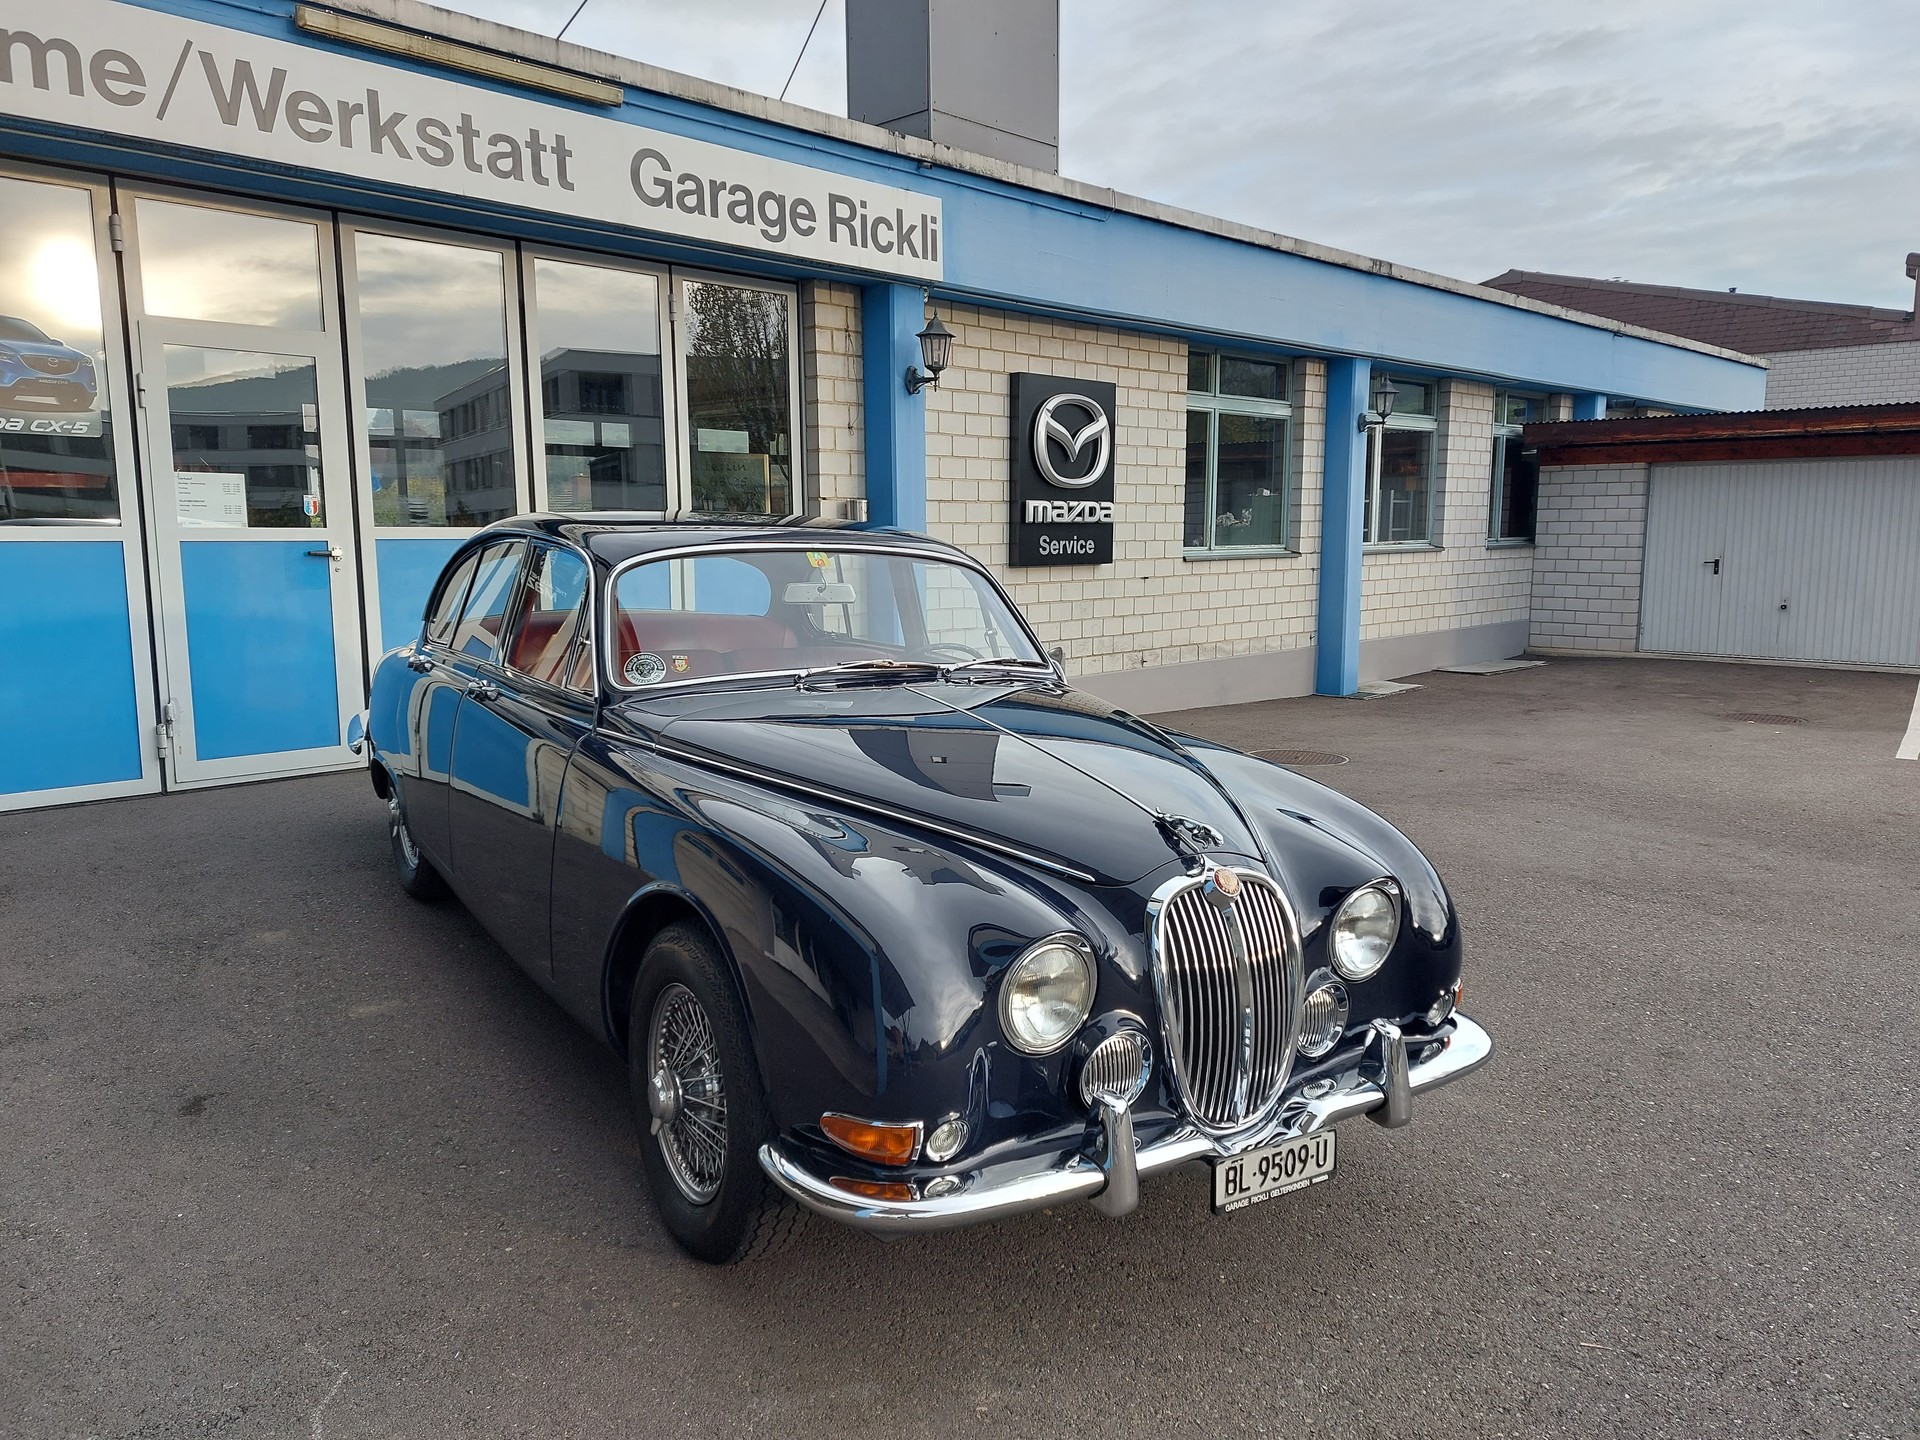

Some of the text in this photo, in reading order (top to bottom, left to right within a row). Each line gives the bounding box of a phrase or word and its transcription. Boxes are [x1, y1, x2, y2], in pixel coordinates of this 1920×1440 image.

[630, 147, 938, 262] Garage Rickli
[30, 419, 91, 434] CX-5
[1039, 535, 1095, 555] Service
[1225, 1198, 1250, 1212] GARAGE
[1250, 1192, 1270, 1204] RICKLI
[1270, 1178, 1310, 1197] GELTERKINDEN
